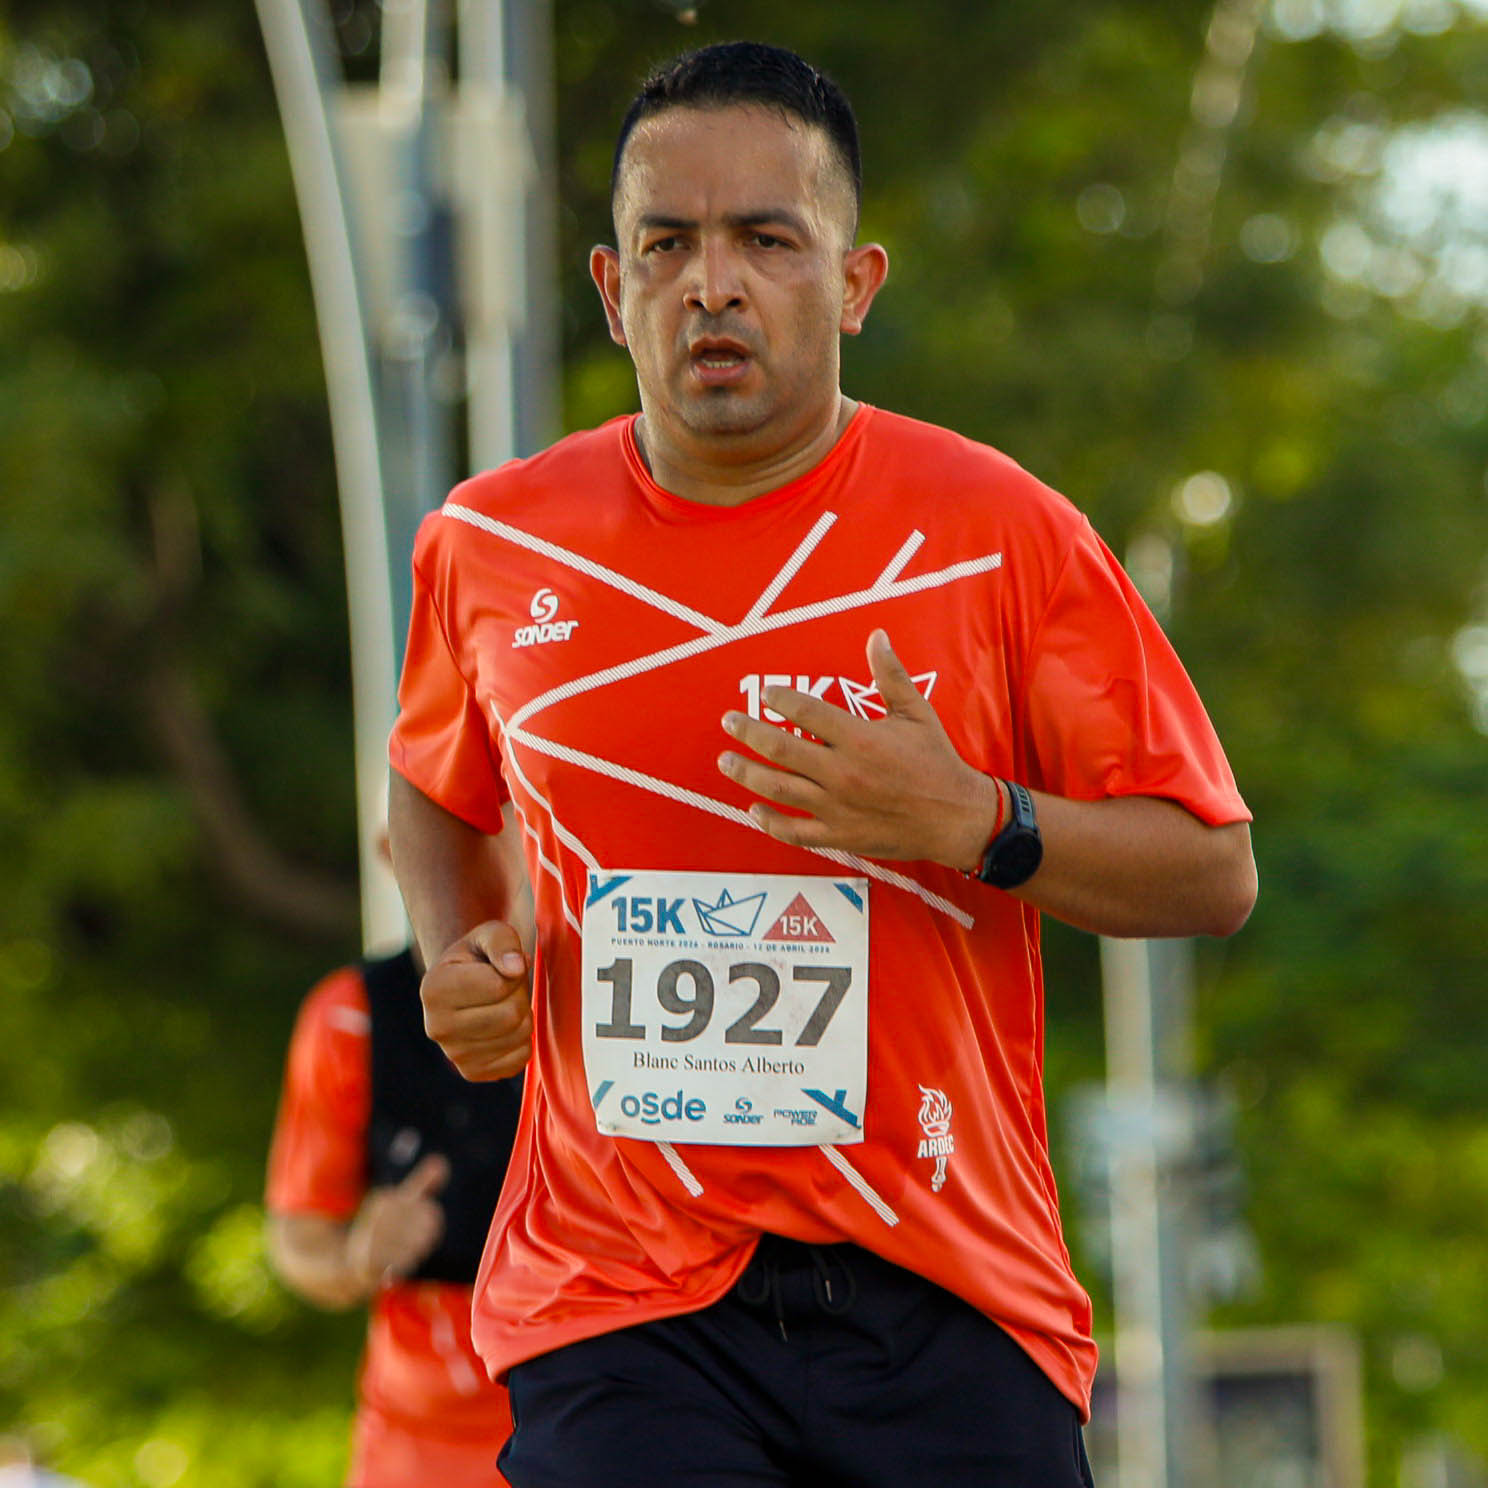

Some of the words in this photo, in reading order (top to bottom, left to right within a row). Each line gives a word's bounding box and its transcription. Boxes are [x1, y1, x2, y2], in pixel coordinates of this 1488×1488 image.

[611, 896, 686, 935] 15K
[779, 914, 818, 937] 15K
[611, 938, 645, 947] PUERTO
[647, 939, 675, 948] NORTE
[707, 941, 744, 952] ROSARIO
[766, 943, 777, 952] DE
[780, 943, 806, 953] ABRIL
[595, 957, 853, 1049] 1927
[632, 1051, 678, 1071] Blanc
[683, 1053, 736, 1072] Santos
[742, 1055, 805, 1075] Alberto
[620, 1089, 707, 1123] osde
